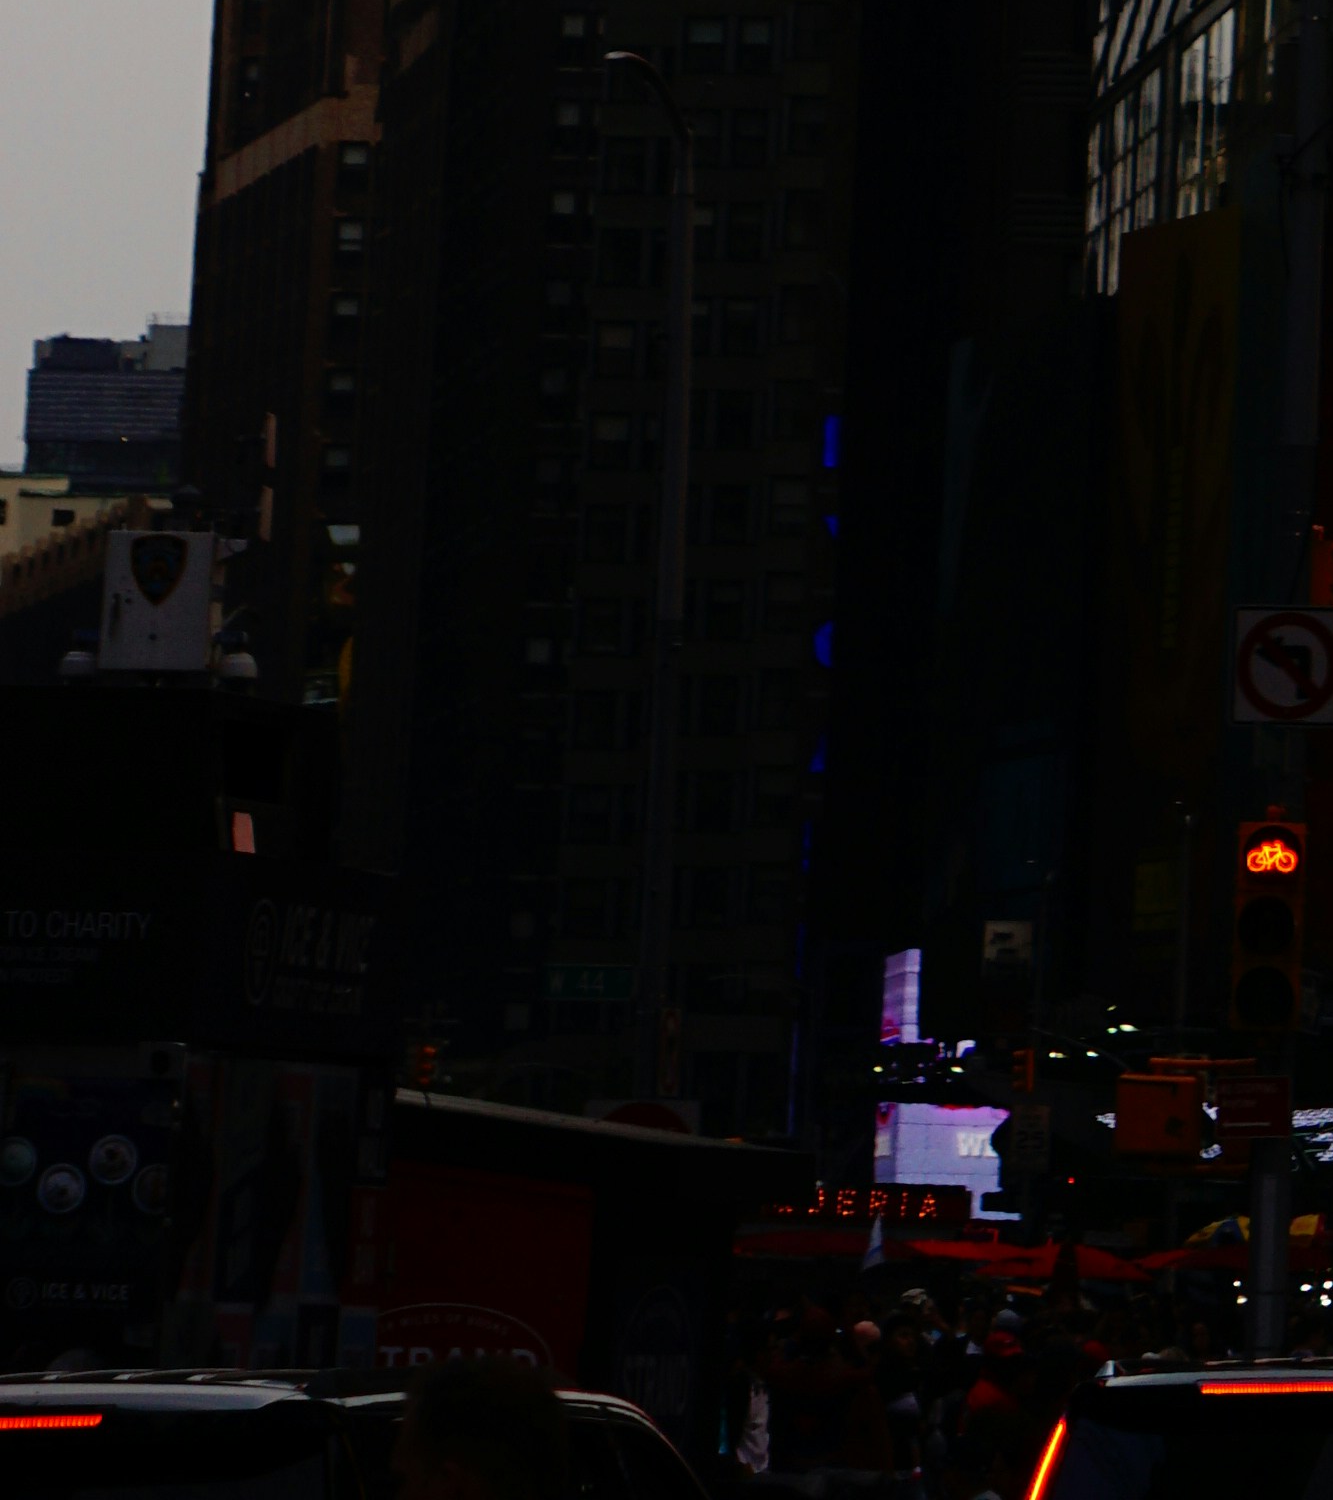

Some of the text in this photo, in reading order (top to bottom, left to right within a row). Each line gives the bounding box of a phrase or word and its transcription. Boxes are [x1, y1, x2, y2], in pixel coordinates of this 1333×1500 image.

[3, 910, 152, 941] TO CHARITY
[547, 971, 606, 995] W 44
[41, 1282, 130, 1302] ICE & VICE
